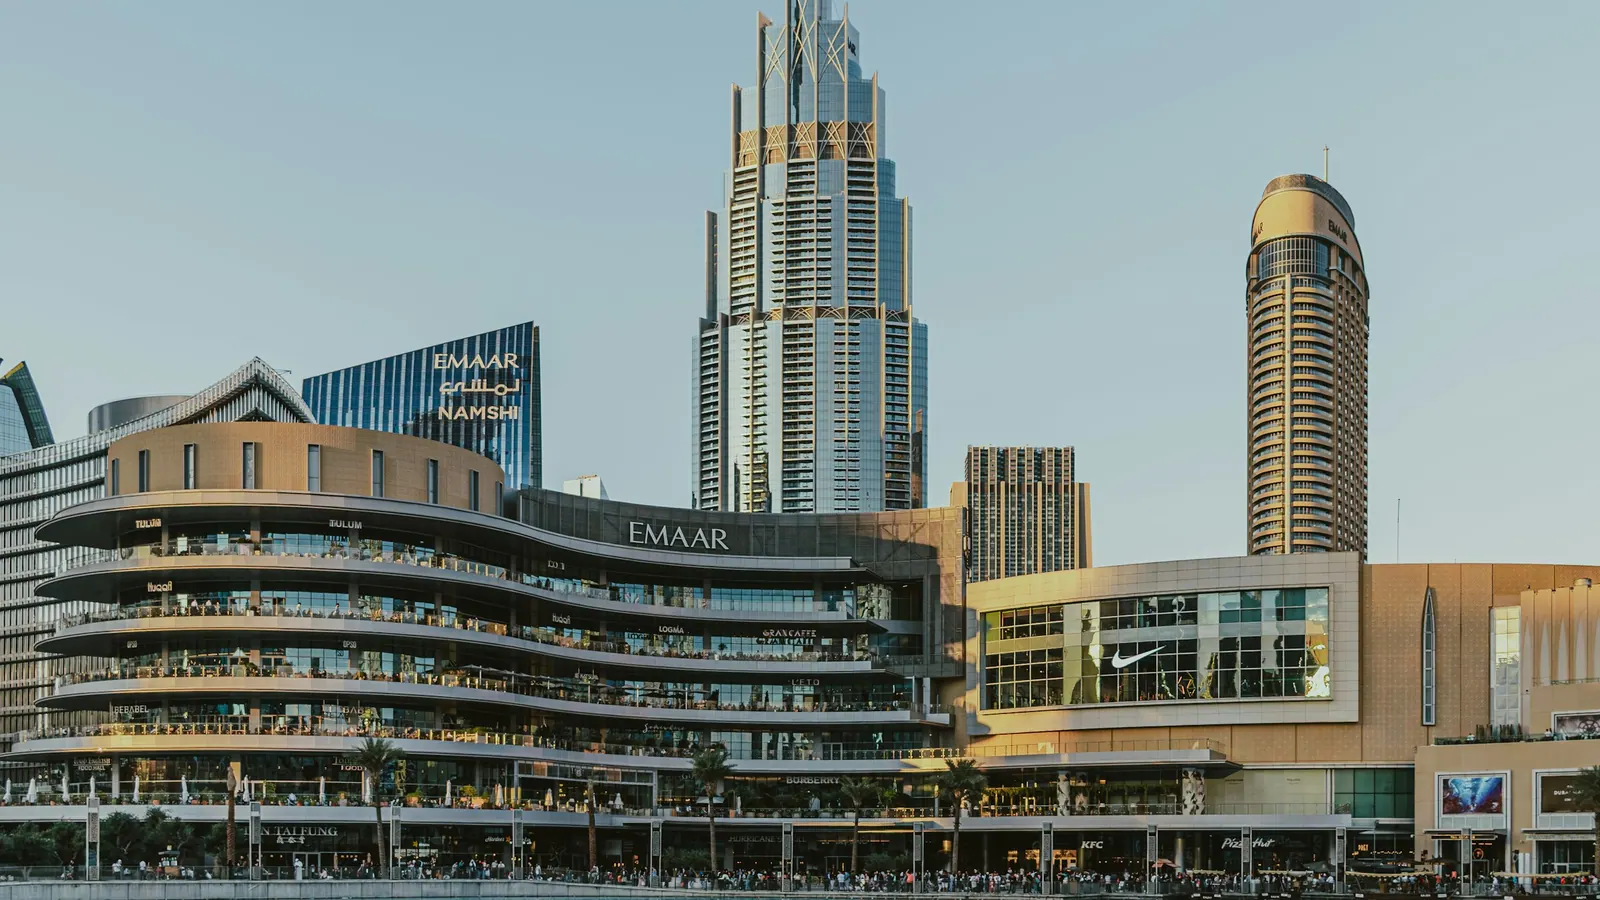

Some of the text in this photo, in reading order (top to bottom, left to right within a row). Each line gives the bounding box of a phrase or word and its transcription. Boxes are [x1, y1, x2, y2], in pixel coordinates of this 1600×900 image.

[1328, 219, 1348, 244] EMAAR
[434, 353, 520, 369] EMAAR
[437, 405, 519, 420] NAMSHI
[135, 518, 162, 529] TULUM
[329, 519, 363, 529] TULUM
[629, 521, 730, 550] EMAAR
[786, 775, 840, 784] BURBERRY
[274, 826, 299, 836] TAI
[301, 826, 338, 836] FUNG
[1081, 840, 1104, 849] KFC
[1252, 837, 1275, 848] Hut
